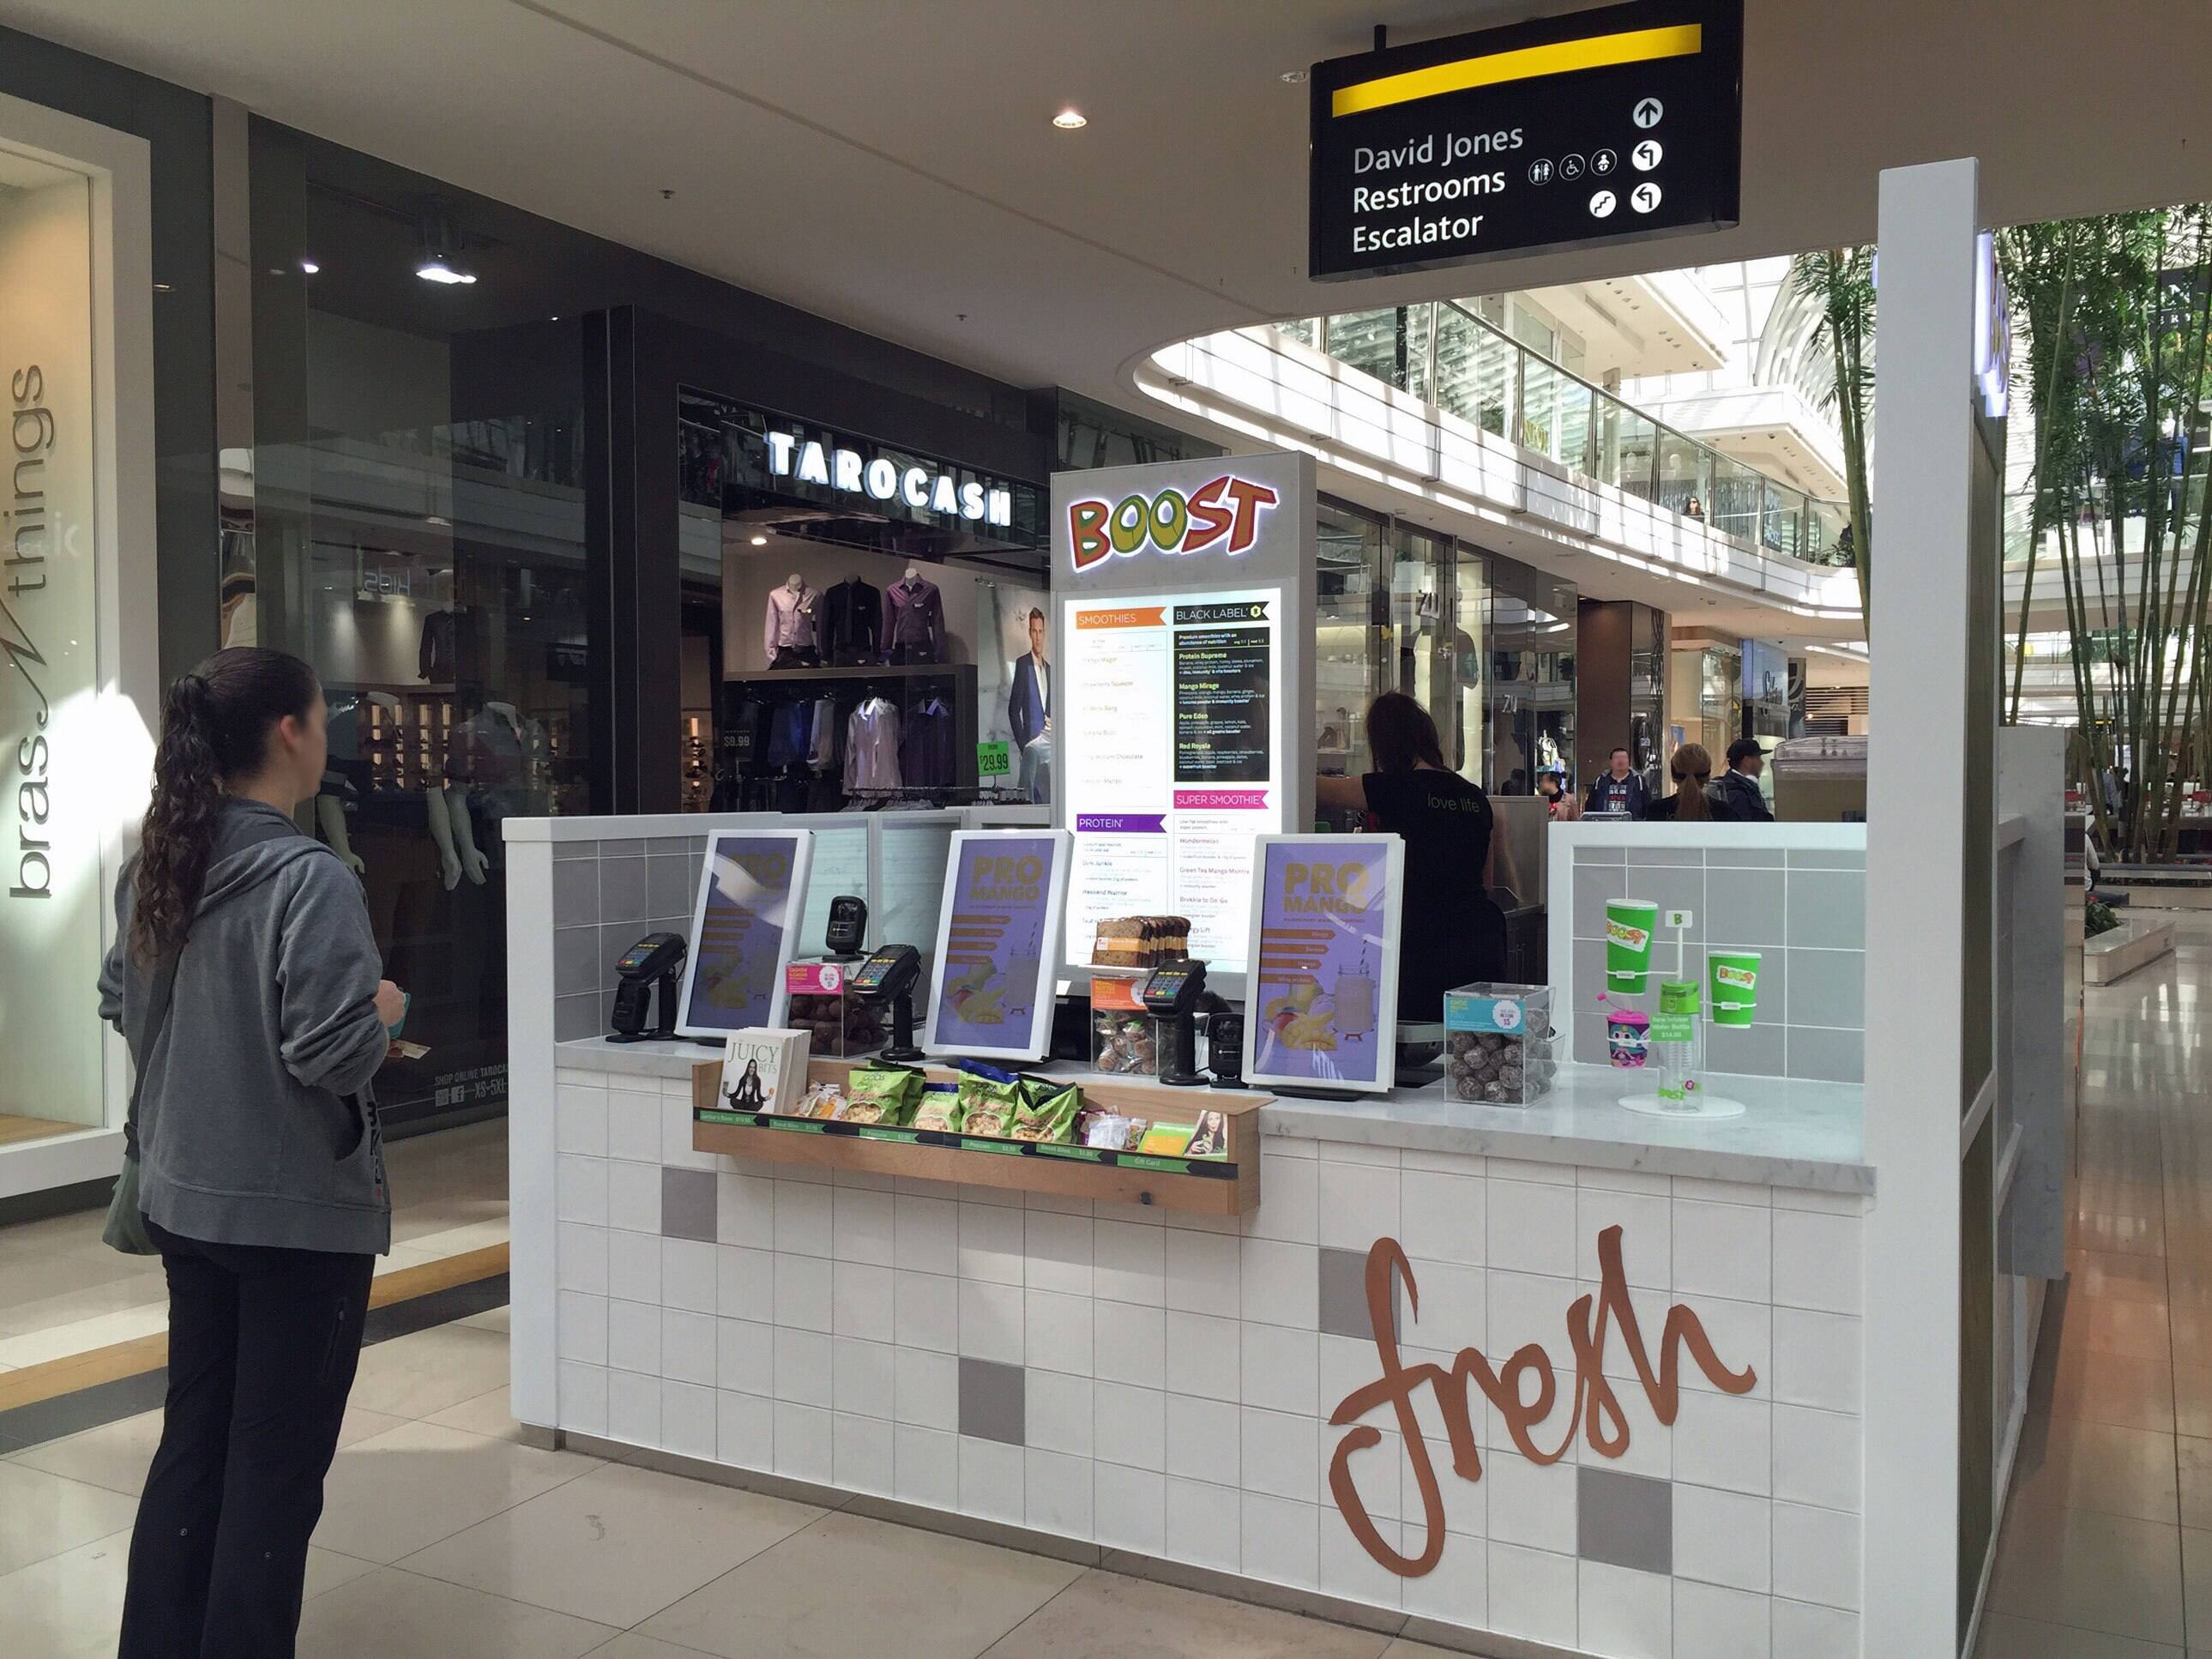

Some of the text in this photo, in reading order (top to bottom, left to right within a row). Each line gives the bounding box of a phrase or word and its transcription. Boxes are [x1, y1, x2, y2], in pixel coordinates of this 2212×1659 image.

[1353, 128, 1523, 174] David Jones
[1353, 171, 1505, 214] Restrooms
[1353, 215, 1484, 253] Escalator
[3, 364, 55, 598] things
[766, 431, 1011, 528] TAROCASH
[1070, 475, 1278, 570] BOOST
[1078, 612, 1137, 625] SMOOTHIES
[1176, 607, 1247, 621] BLACK LABEL
[1201, 652, 1227, 661] Supreme
[979, 753, 1009, 771] $29.99
[1176, 794, 1260, 805] SUPER SMOOTHIE
[1426, 792, 1480, 812] love life
[9, 734, 52, 899] bras
[1078, 817, 1123, 829] PROTEIN
[973, 854, 1044, 885] PRO
[1284, 862, 1369, 895] PRO
[969, 885, 1040, 902] MANGO
[1283, 896, 1367, 914] MANGO
[1673, 913, 1684, 926] B
[727, 1042, 780, 1064] JUICY
[435, 1073, 454, 1086] SHOP
[454, 1069, 479, 1083] ONLINE
[758, 1063, 777, 1074] BITS
[1328, 1224, 1758, 1578] fresh
